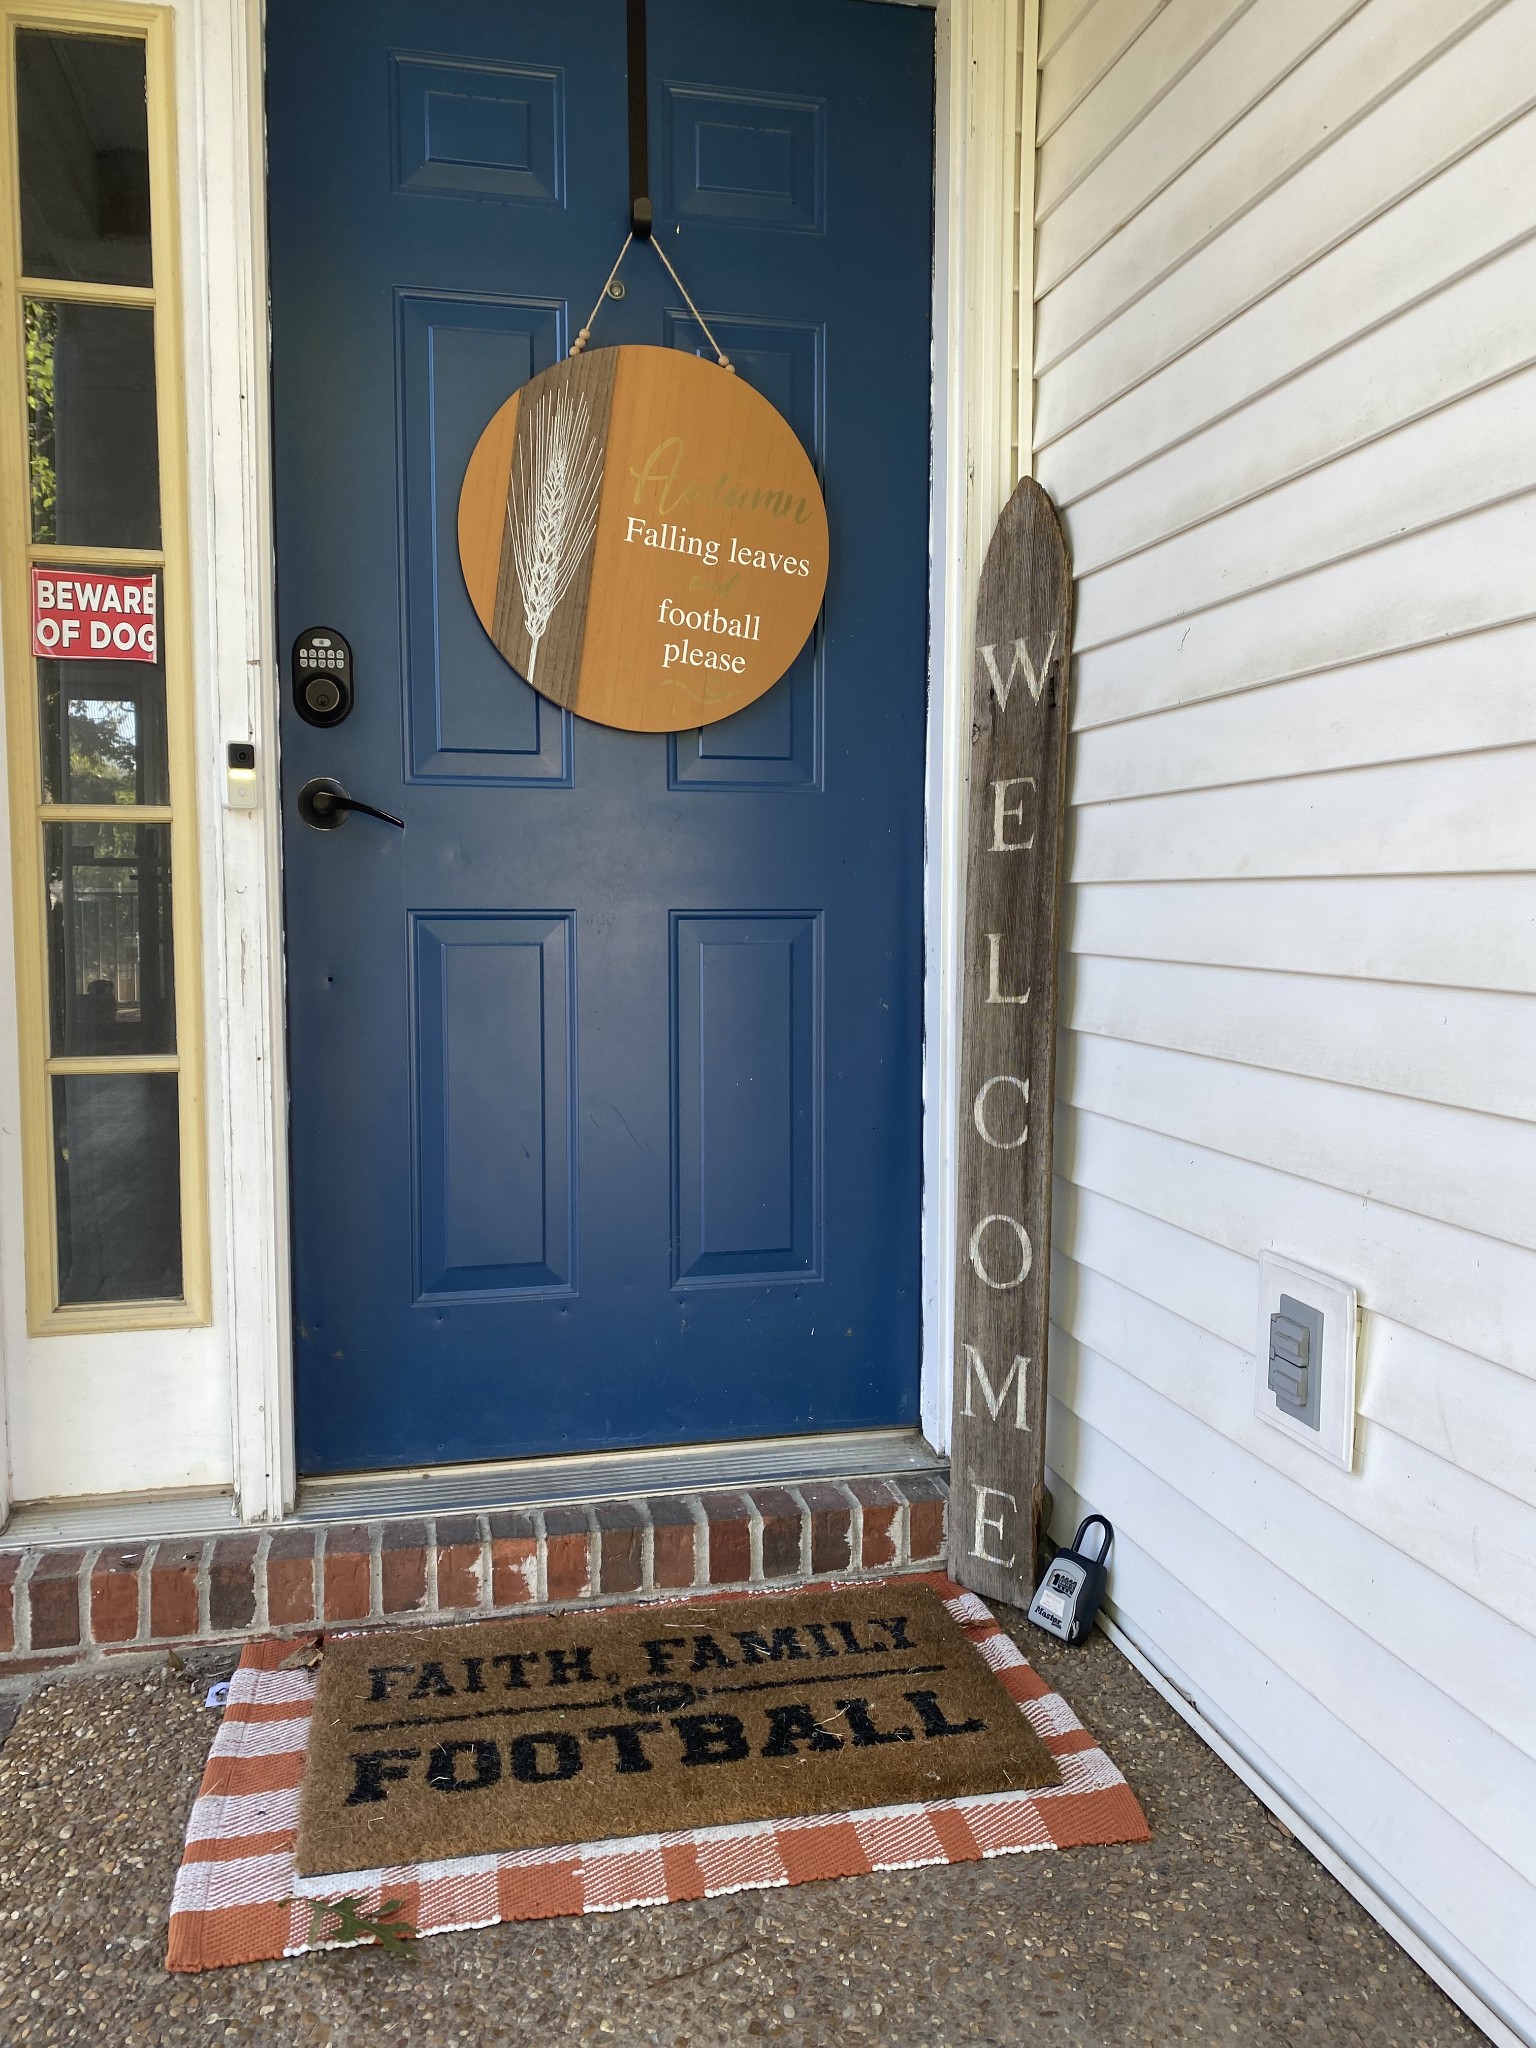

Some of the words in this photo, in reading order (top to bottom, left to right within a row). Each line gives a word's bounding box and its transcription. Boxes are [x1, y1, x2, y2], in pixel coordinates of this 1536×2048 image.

[623, 516, 721, 566] Falling
[727, 537, 810, 577] leaves
[37, 579, 155, 615] BEWARE
[36, 617, 80, 648] OF
[90, 620, 155, 653] DOG
[656, 598, 760, 641] football
[661, 639, 746, 674] please
[959, 630, 1061, 1568] WELCOME
[1034, 1605, 1063, 1625] Master
[639, 1615, 918, 1674] FAMILY
[344, 1690, 988, 1806] FOOTBALL
